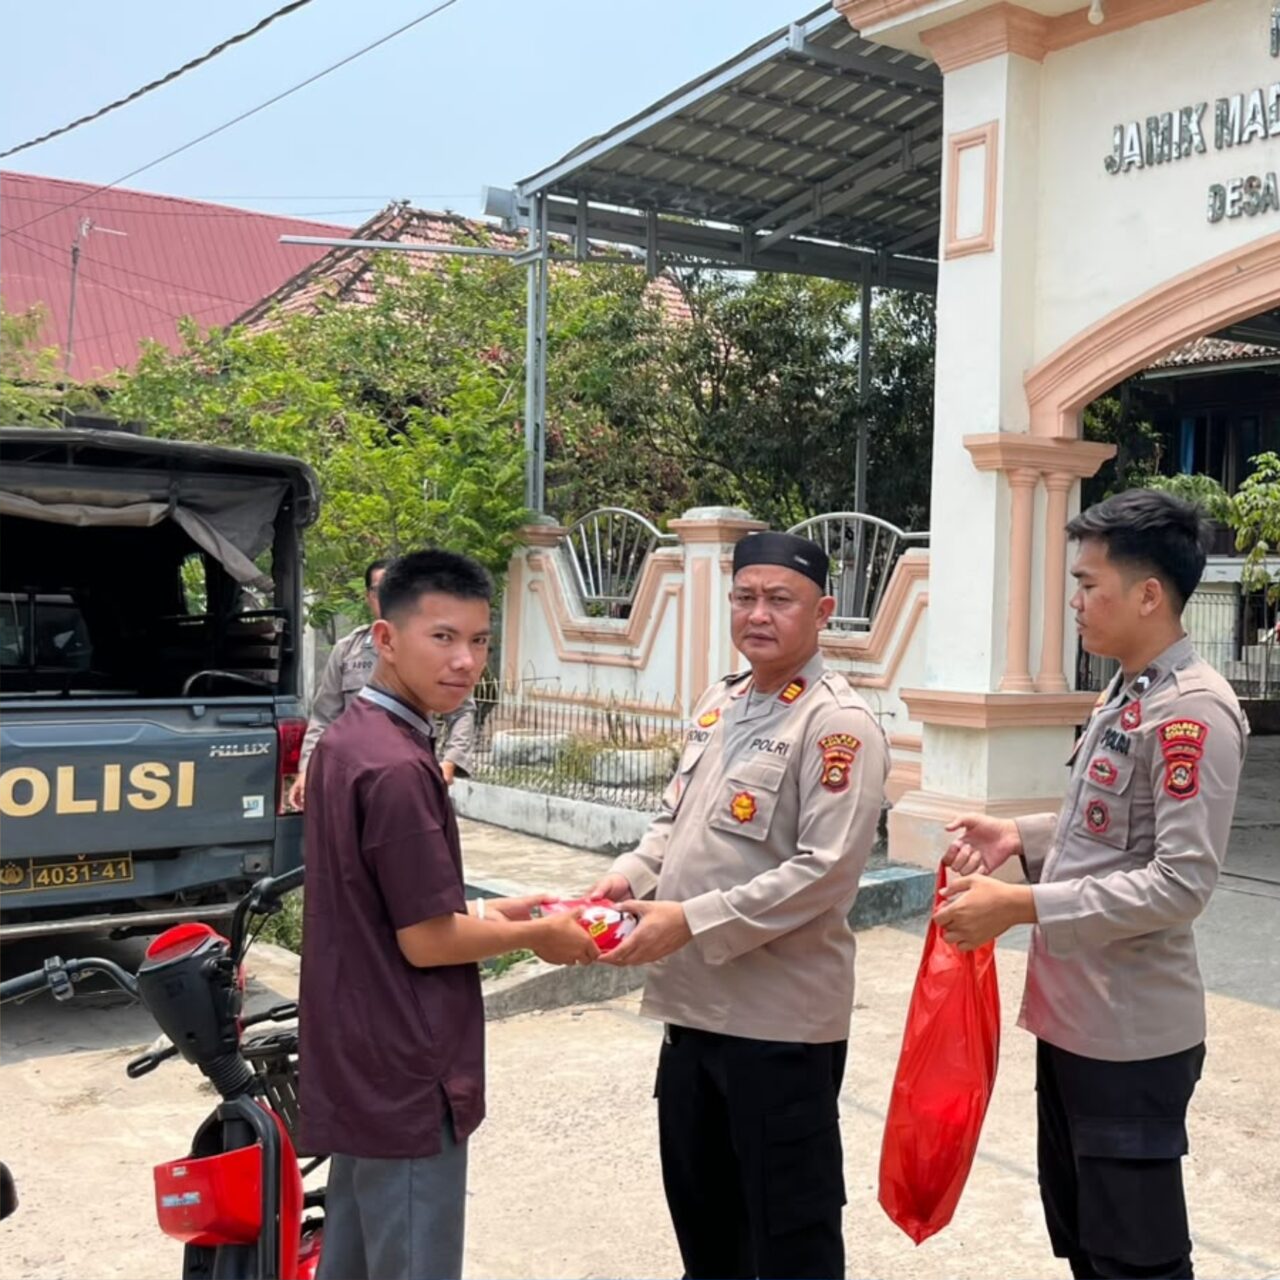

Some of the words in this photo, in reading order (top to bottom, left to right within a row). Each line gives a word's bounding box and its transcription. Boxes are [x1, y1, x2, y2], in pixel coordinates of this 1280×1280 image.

[1104, 102, 1208, 176] JAMIK
[1207, 172, 1280, 223] DESA
[209, 743, 271, 757] HILUX
[750, 738, 790, 756] POLRI
[0, 761, 195, 817] OLISI
